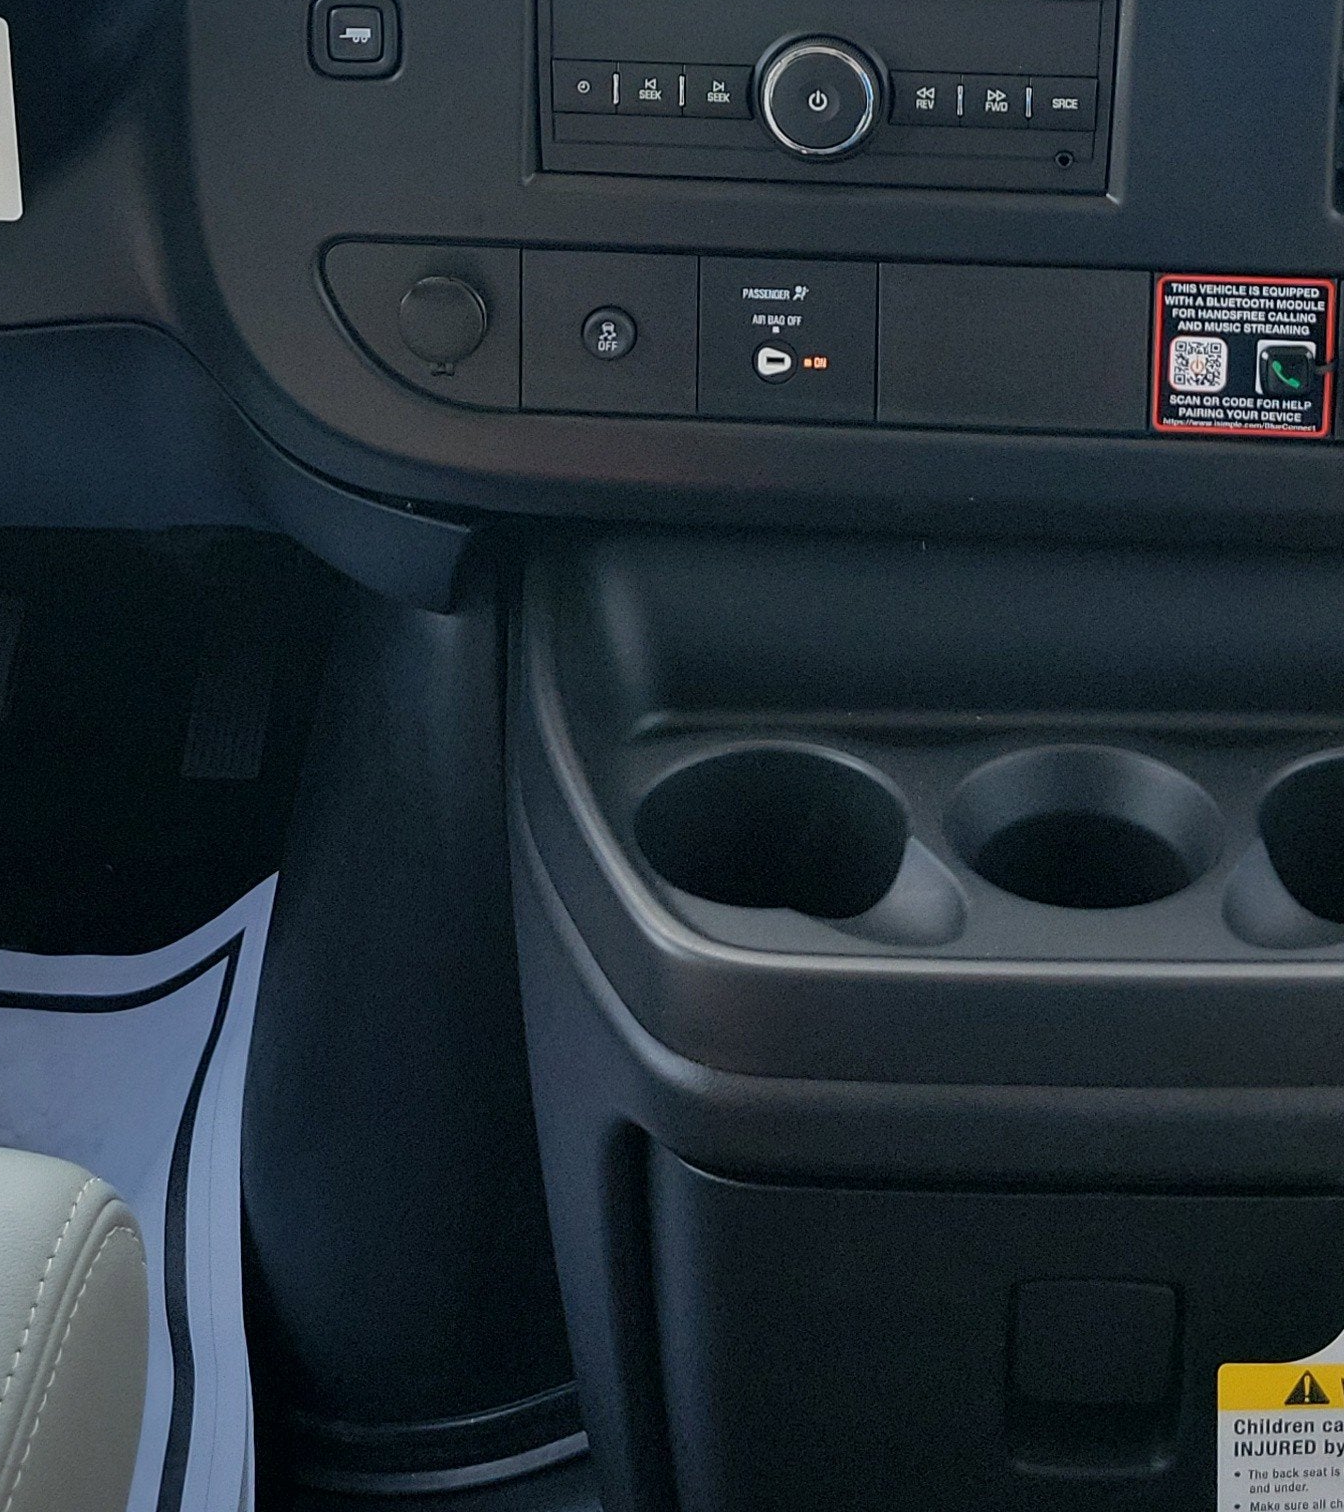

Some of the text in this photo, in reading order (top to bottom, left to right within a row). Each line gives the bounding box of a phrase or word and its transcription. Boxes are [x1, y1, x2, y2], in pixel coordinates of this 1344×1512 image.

[639, 90, 662, 100] SEEK
[707, 92, 730, 103] SEEK
[916, 99, 935, 109] REV
[985, 102, 1008, 112] FWD
[1052, 98, 1078, 109] SRCE
[743, 288, 790, 300] PASSENGER
[1171, 283, 1320, 298] THIS VEHICLE IS EQUIPPED
[1164, 295, 1325, 311] WITH A BLUETOOTH MODULE
[752, 315, 765, 325] AIR
[787, 316, 802, 326] OFF
[1172, 308, 1316, 323] FOR HANDSFREE CALLING
[1178, 320, 1310, 335] AND MUSIC STREAMING
[598, 340, 618, 351] OFF
[1169, 394, 1312, 411] SCAN QR CODE FOR HELP
[1178, 407, 1302, 422] PAIRING YOUR DEVICE
[1234, 1418, 1314, 1435] Children
[1234, 1440, 1316, 1457] INJURED
[1248, 1469, 1268, 1480] The
[1273, 1467, 1299, 1479] back
[1303, 1467, 1327, 1478] seat
[1331, 1466, 1340, 1477] is
[1250, 1482, 1308, 1494] and under.
[1250, 1501, 1280, 1512] Make
[1284, 1500, 1309, 1511] sure
[1313, 1499, 1326, 1510] all
